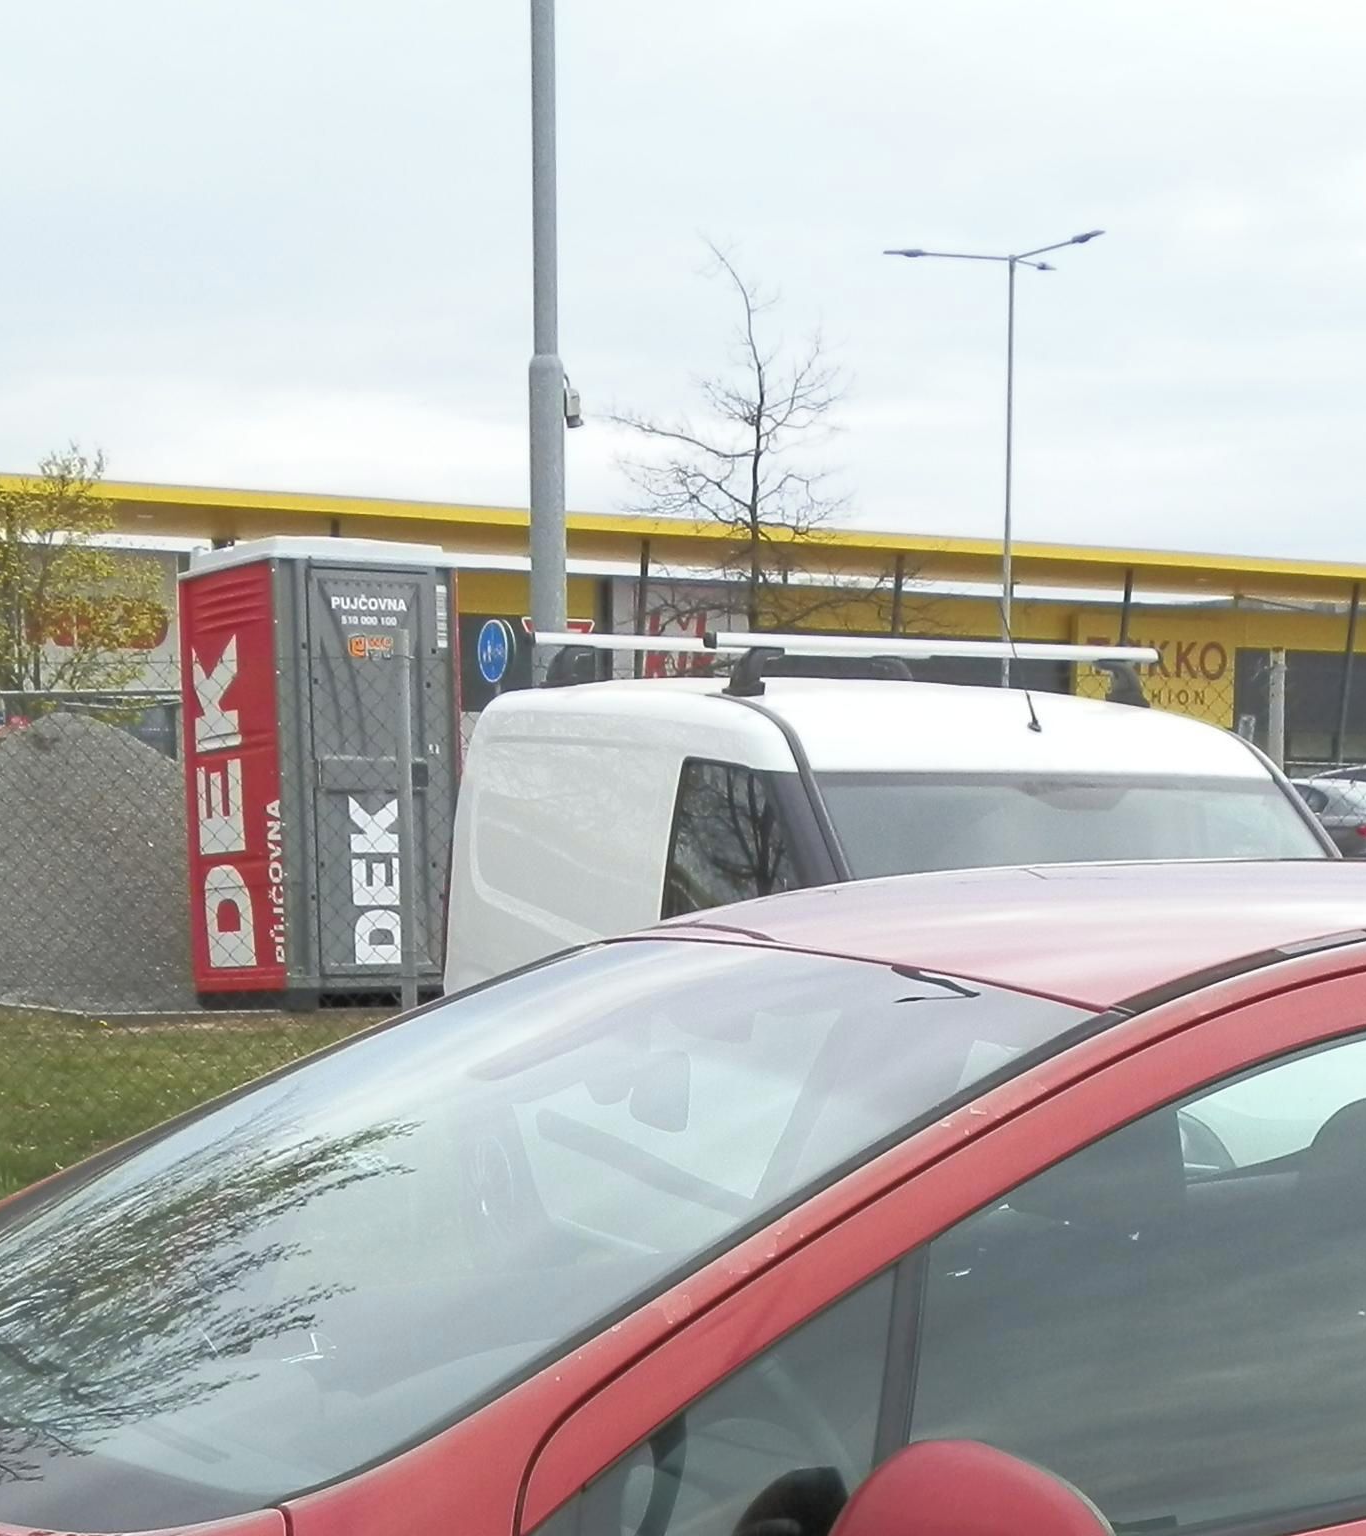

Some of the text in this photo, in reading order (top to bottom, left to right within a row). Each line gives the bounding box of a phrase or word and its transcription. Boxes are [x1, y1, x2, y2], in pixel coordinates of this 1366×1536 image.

[1087, 637, 1228, 680] KKO
[191, 634, 257, 967] DEK
[348, 796, 402, 964] DEK
